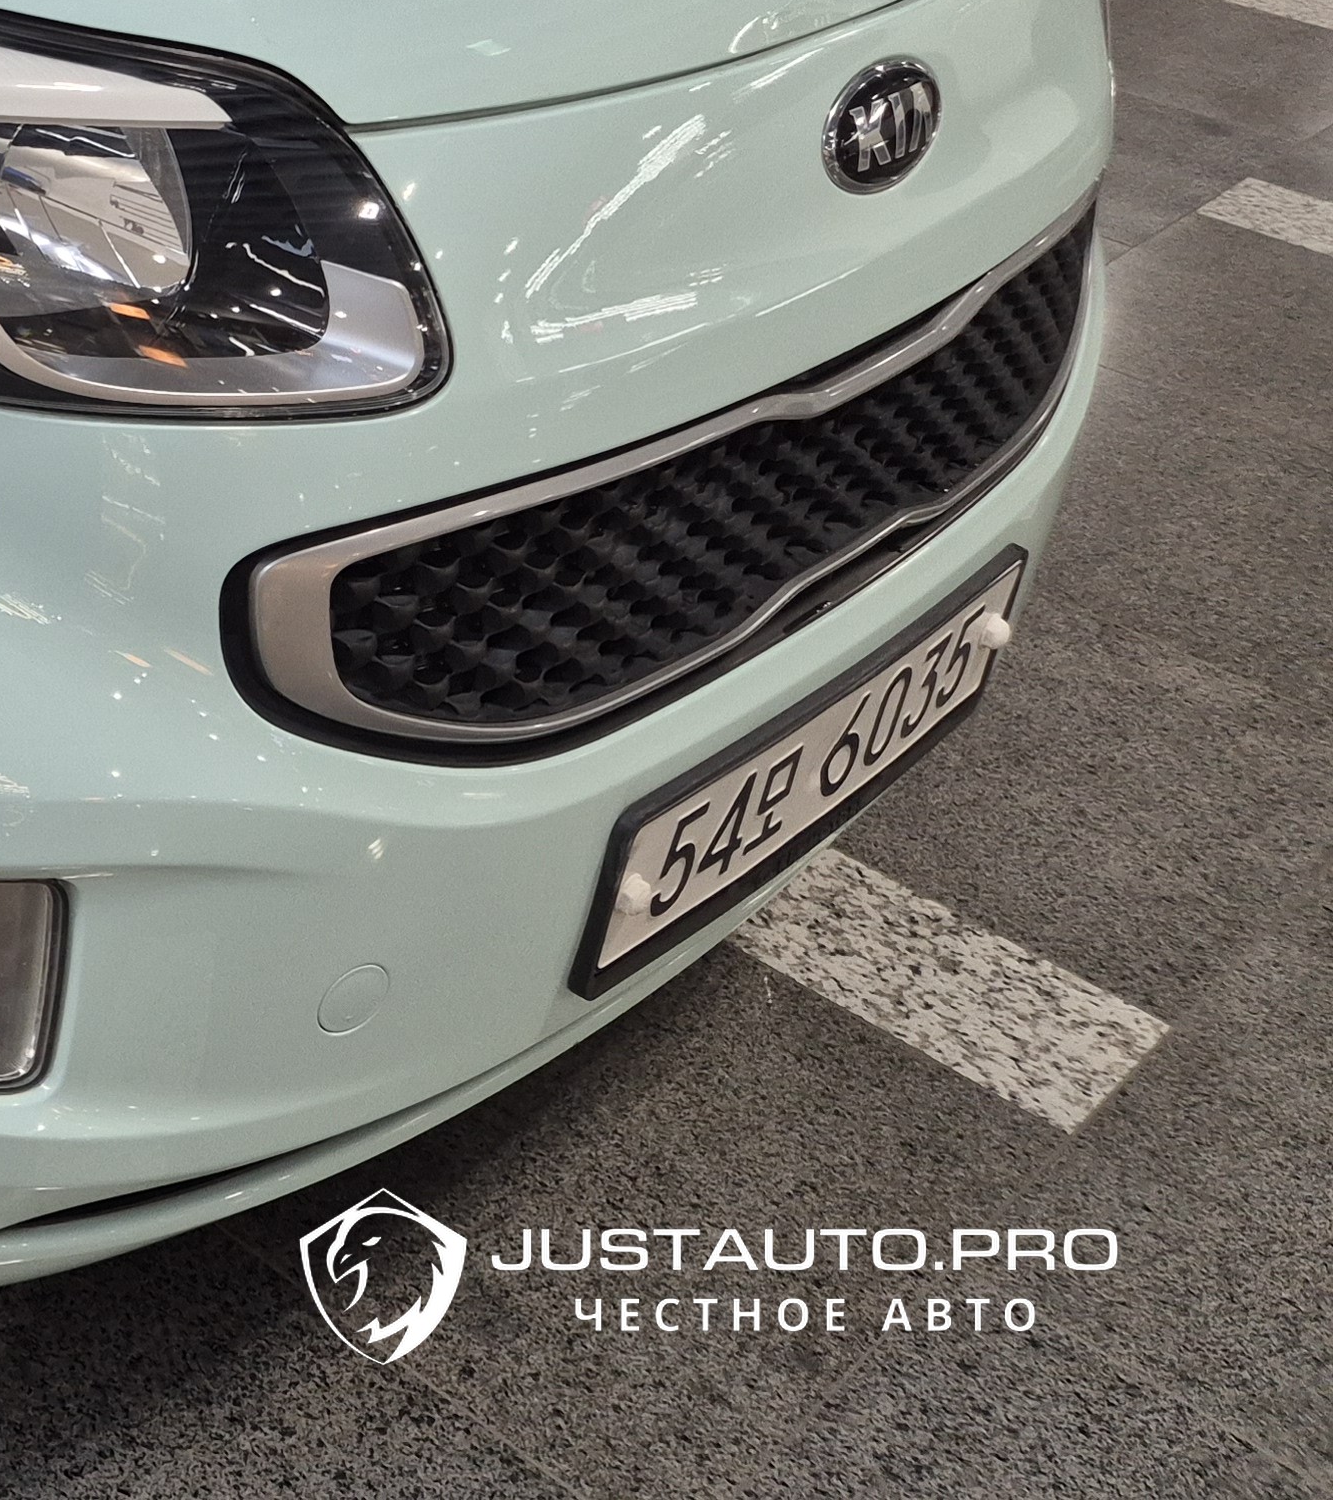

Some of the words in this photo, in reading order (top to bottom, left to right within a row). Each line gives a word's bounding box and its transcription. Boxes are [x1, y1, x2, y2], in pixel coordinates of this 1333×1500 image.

[848, 81, 934, 174] KIA
[649, 745, 805, 918] 54모
[819, 603, 986, 798] 6035
